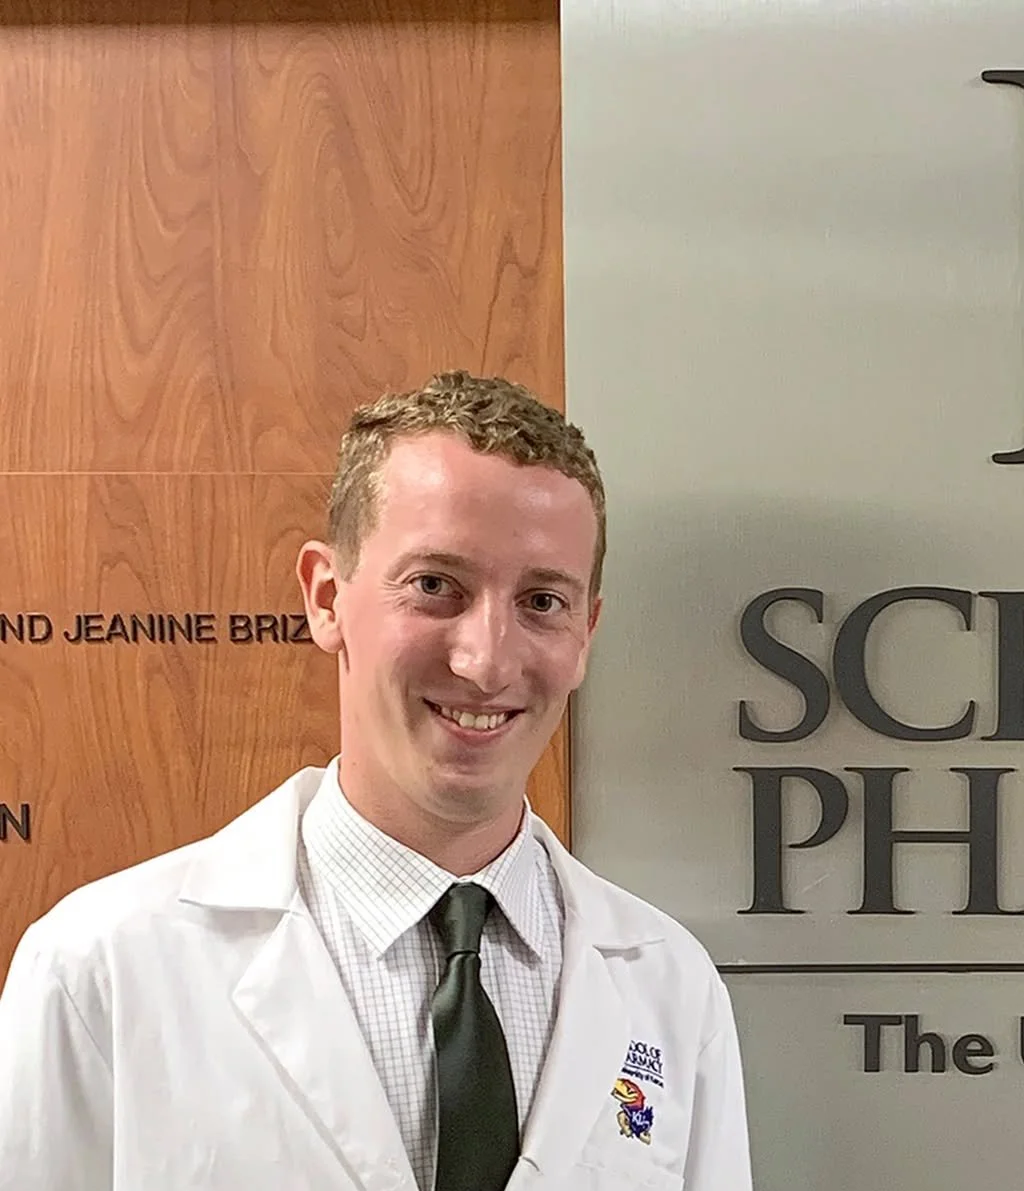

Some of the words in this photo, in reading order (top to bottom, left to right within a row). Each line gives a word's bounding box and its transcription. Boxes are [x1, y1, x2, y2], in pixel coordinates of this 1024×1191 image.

[63, 612, 217, 644] JEANINE
[228, 612, 315, 644] BRIZ
[843, 1012, 995, 1077] The
